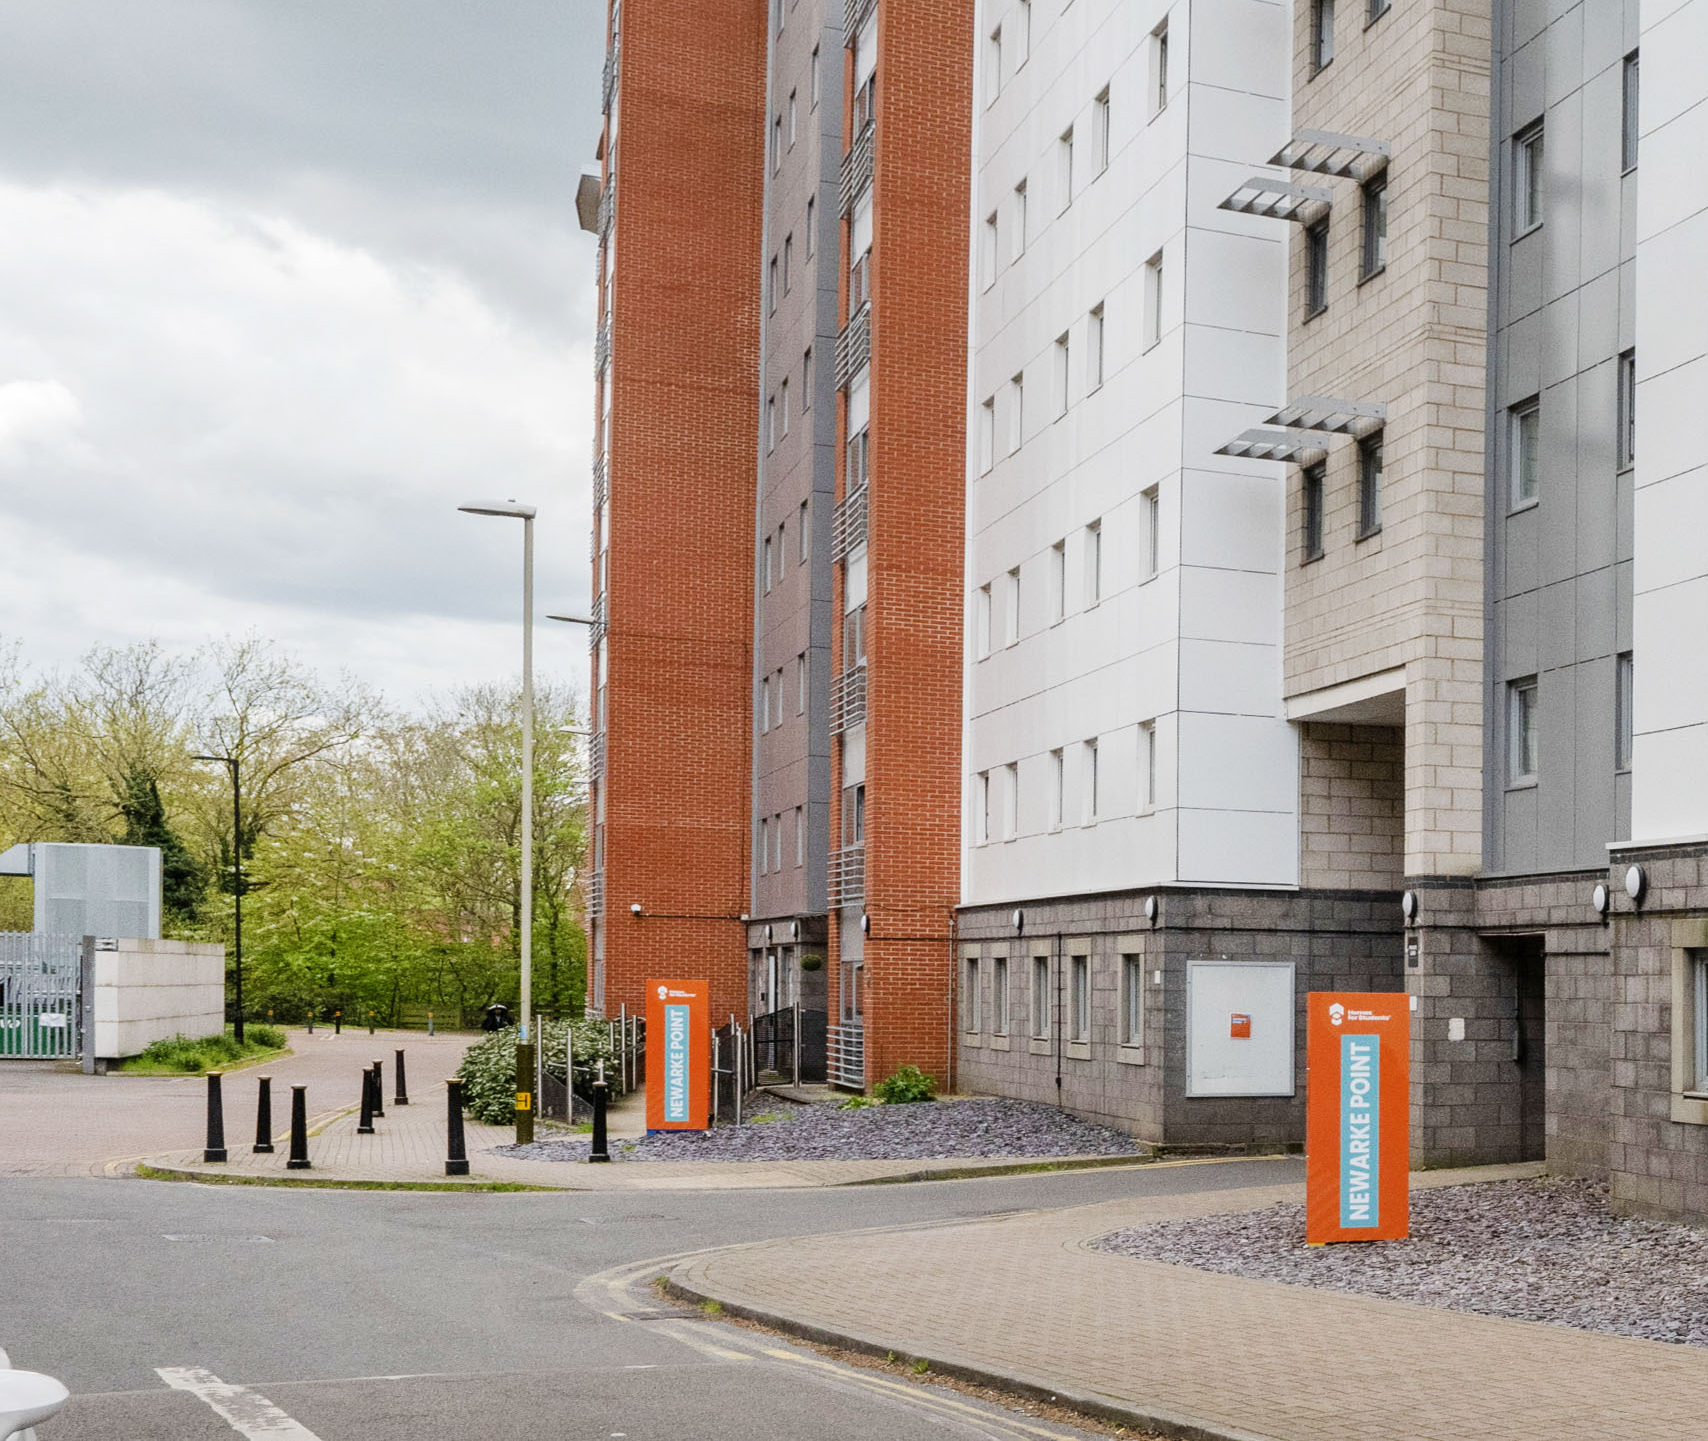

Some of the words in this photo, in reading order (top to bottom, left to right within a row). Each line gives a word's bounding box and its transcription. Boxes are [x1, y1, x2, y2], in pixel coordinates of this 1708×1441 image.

[670, 1009, 684, 1050] POINT
[670, 1052, 684, 1117] NEWARKE
[1349, 1042, 1371, 1108] POINT
[1349, 1113, 1371, 1220] NEWARKE
